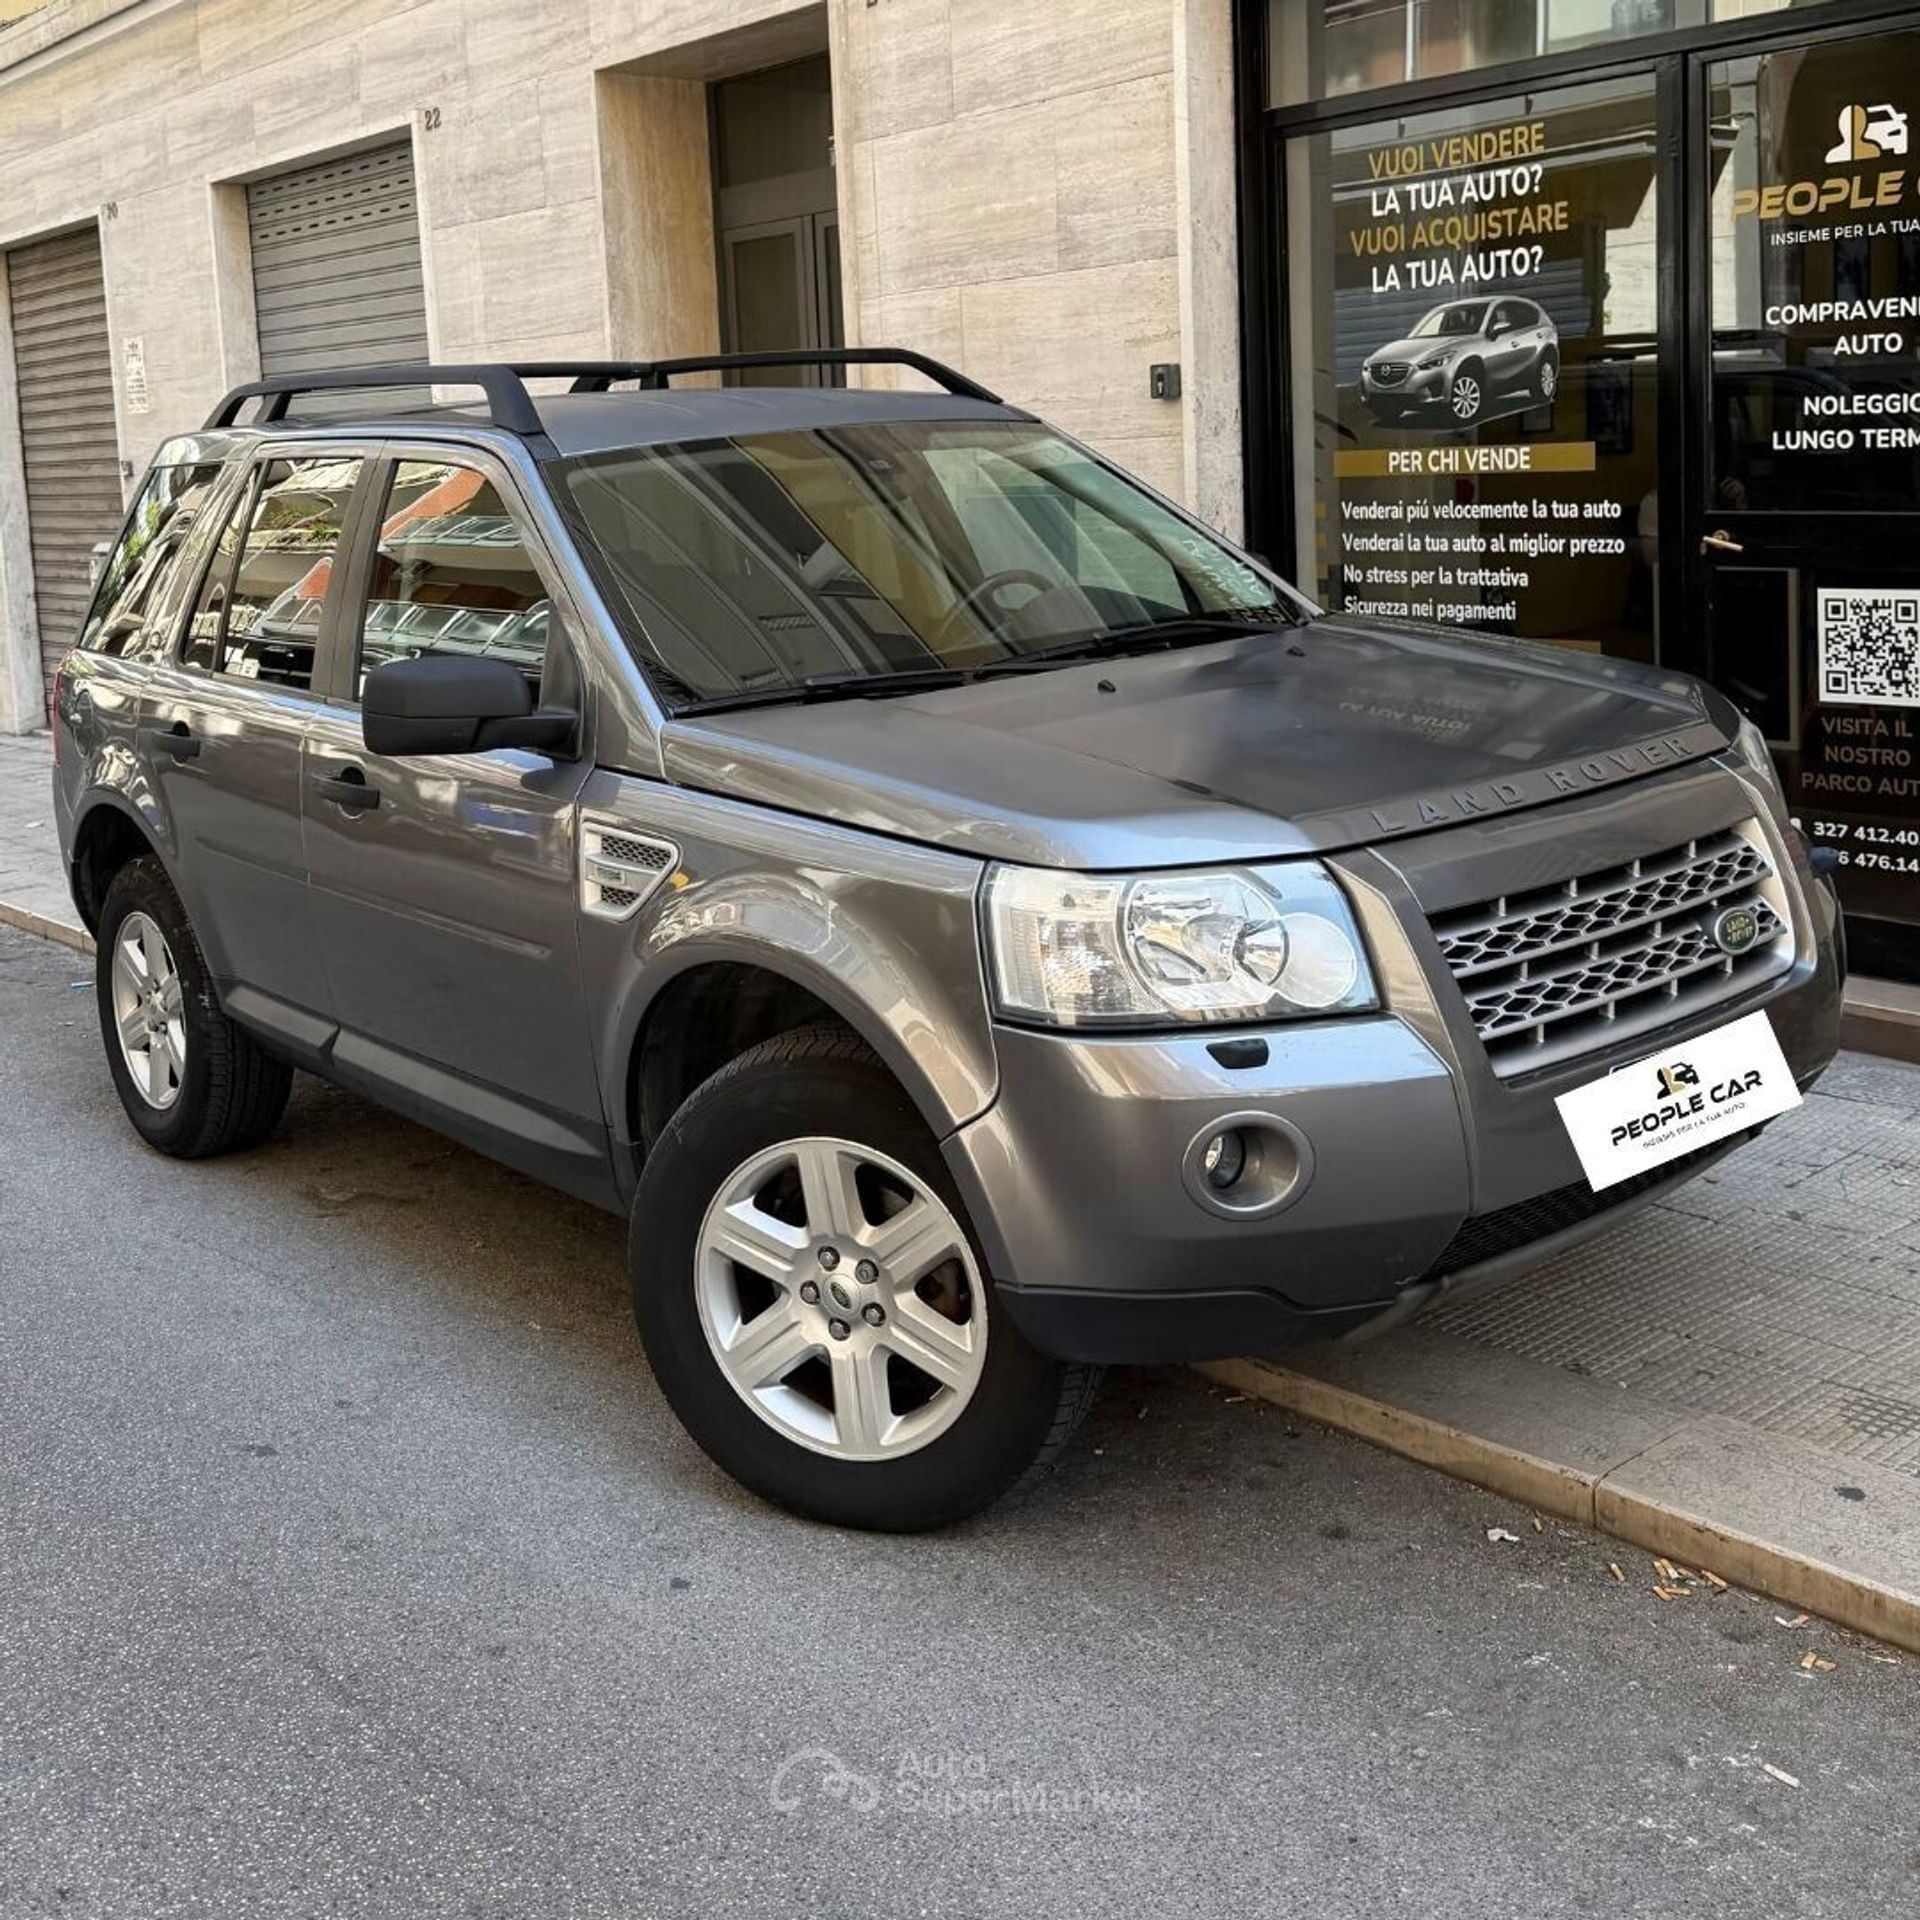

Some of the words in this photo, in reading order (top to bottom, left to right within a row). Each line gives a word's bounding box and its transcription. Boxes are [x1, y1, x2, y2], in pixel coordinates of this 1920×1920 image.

[424, 106, 442, 131] 22
[1369, 144, 1425, 180] VUOI
[1431, 122, 1545, 168] VENDERE
[1371, 187, 1400, 217] LA
[1406, 177, 1454, 211] TUA
[1461, 164, 1543, 204] AUTO?
[1731, 170, 1906, 221] PEOPLE
[1350, 223, 1405, 257] VUOI
[1412, 201, 1569, 251] ACQUISTARE
[1770, 227, 1831, 246] INSIEME
[1834, 224, 1863, 240] PER
[1868, 222, 1887, 236] LA
[1890, 219, 1920, 233] TUA
[1371, 264, 1400, 293] LA
[1406, 257, 1455, 289] TUA
[1461, 245, 1544, 283] AUTO?
[1833, 332, 1903, 356] AUTO
[1772, 429, 1854, 450] LUNGO
[1388, 450, 1423, 473] PER
[1428, 449, 1459, 472] CHI
[1465, 446, 1531, 470] VENDE
[1342, 500, 1403, 520] Venderai
[1433, 500, 1528, 519] velocemente
[1532, 499, 1548, 519] la
[1551, 501, 1578, 519] tua
[1583, 500, 1621, 519] auto
[1342, 533, 1404, 552] Venderai
[1408, 533, 1421, 552] la
[1424, 535, 1448, 552] tua
[1452, 535, 1486, 552] auto
[1490, 533, 1505, 552] al
[1509, 533, 1565, 557] miglior
[1570, 537, 1625, 558] prezzo
[1343, 565, 1362, 583] No
[1366, 567, 1408, 584] stress
[1411, 569, 1435, 588] per
[1438, 566, 1452, 585] la
[1456, 566, 1529, 587] trattativa
[1344, 596, 1408, 617] Sicurezza
[1411, 598, 1433, 617] nei
[1437, 601, 1516, 622] pagamenti
[1821, 716, 1889, 736] VISITA
[1895, 719, 1914, 738] IL
[1825, 745, 1911, 767] NOSTRO
[1371, 783, 1524, 833] LAND
[1545, 737, 1694, 793] ROVER
[1801, 772, 1872, 792] PARCO
[1813, 821, 1849, 838] 327
